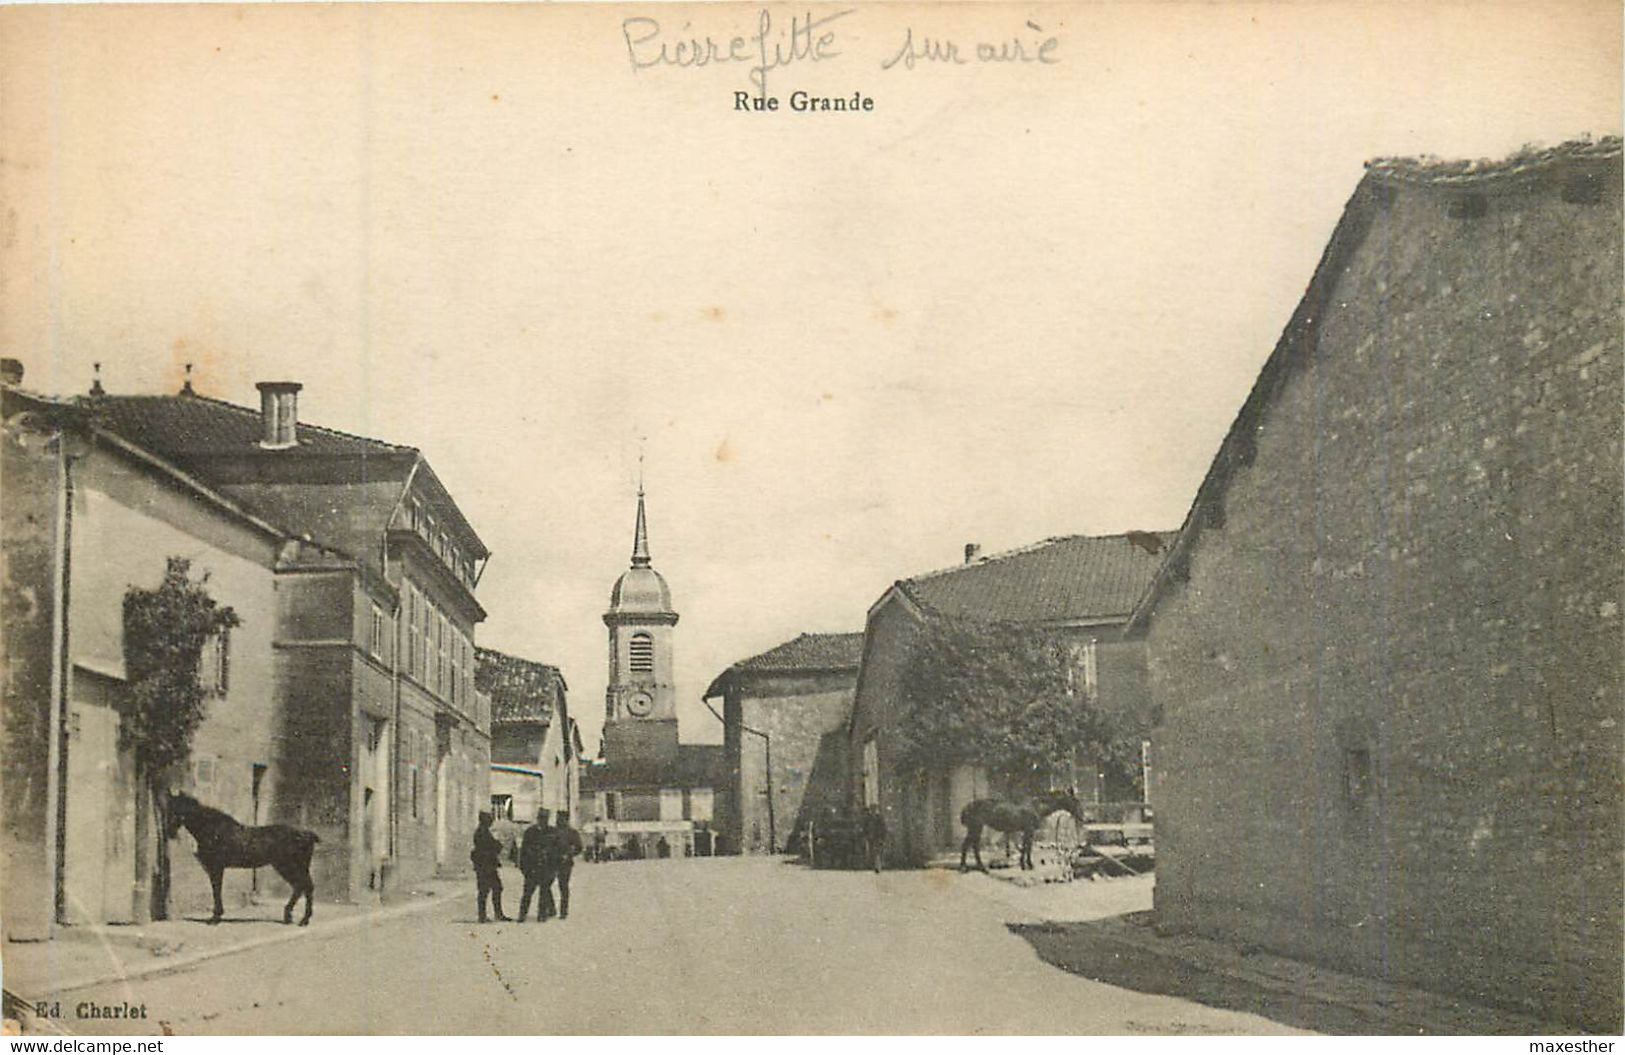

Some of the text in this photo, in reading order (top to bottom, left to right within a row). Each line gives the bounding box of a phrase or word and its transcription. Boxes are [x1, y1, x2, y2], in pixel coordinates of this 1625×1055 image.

[882, 27, 966, 70] sur
[734, 91, 874, 111] Rue Grande
[76, 1002, 148, 1019] Charlet
